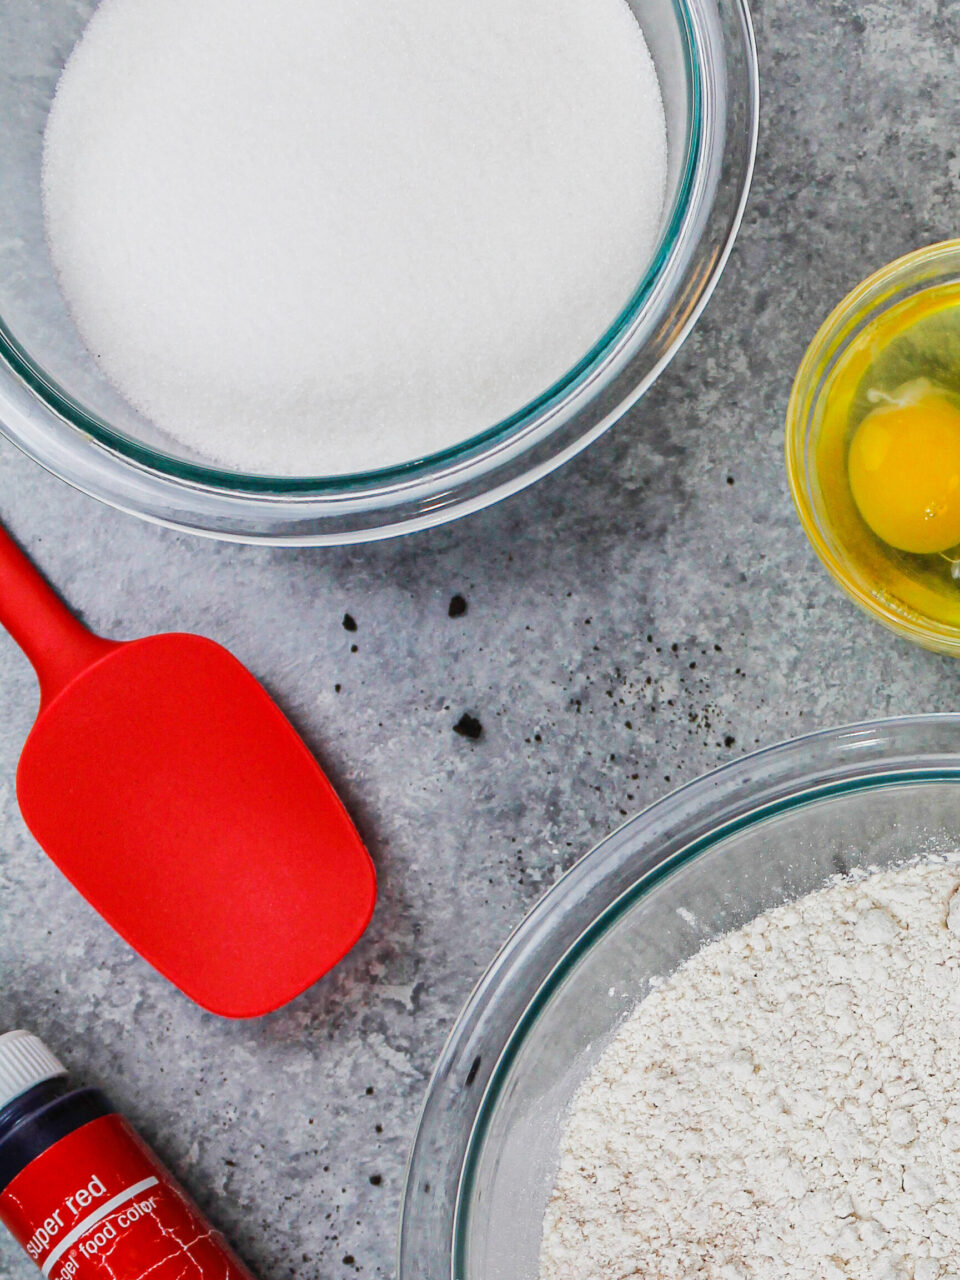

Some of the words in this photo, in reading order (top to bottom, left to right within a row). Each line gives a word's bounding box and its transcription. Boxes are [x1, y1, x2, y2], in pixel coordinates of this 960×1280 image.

[27, 1209, 64, 1259] super
[65, 1174, 107, 1216] red
[79, 1219, 117, 1259] food
[117, 1196, 158, 1229] color
